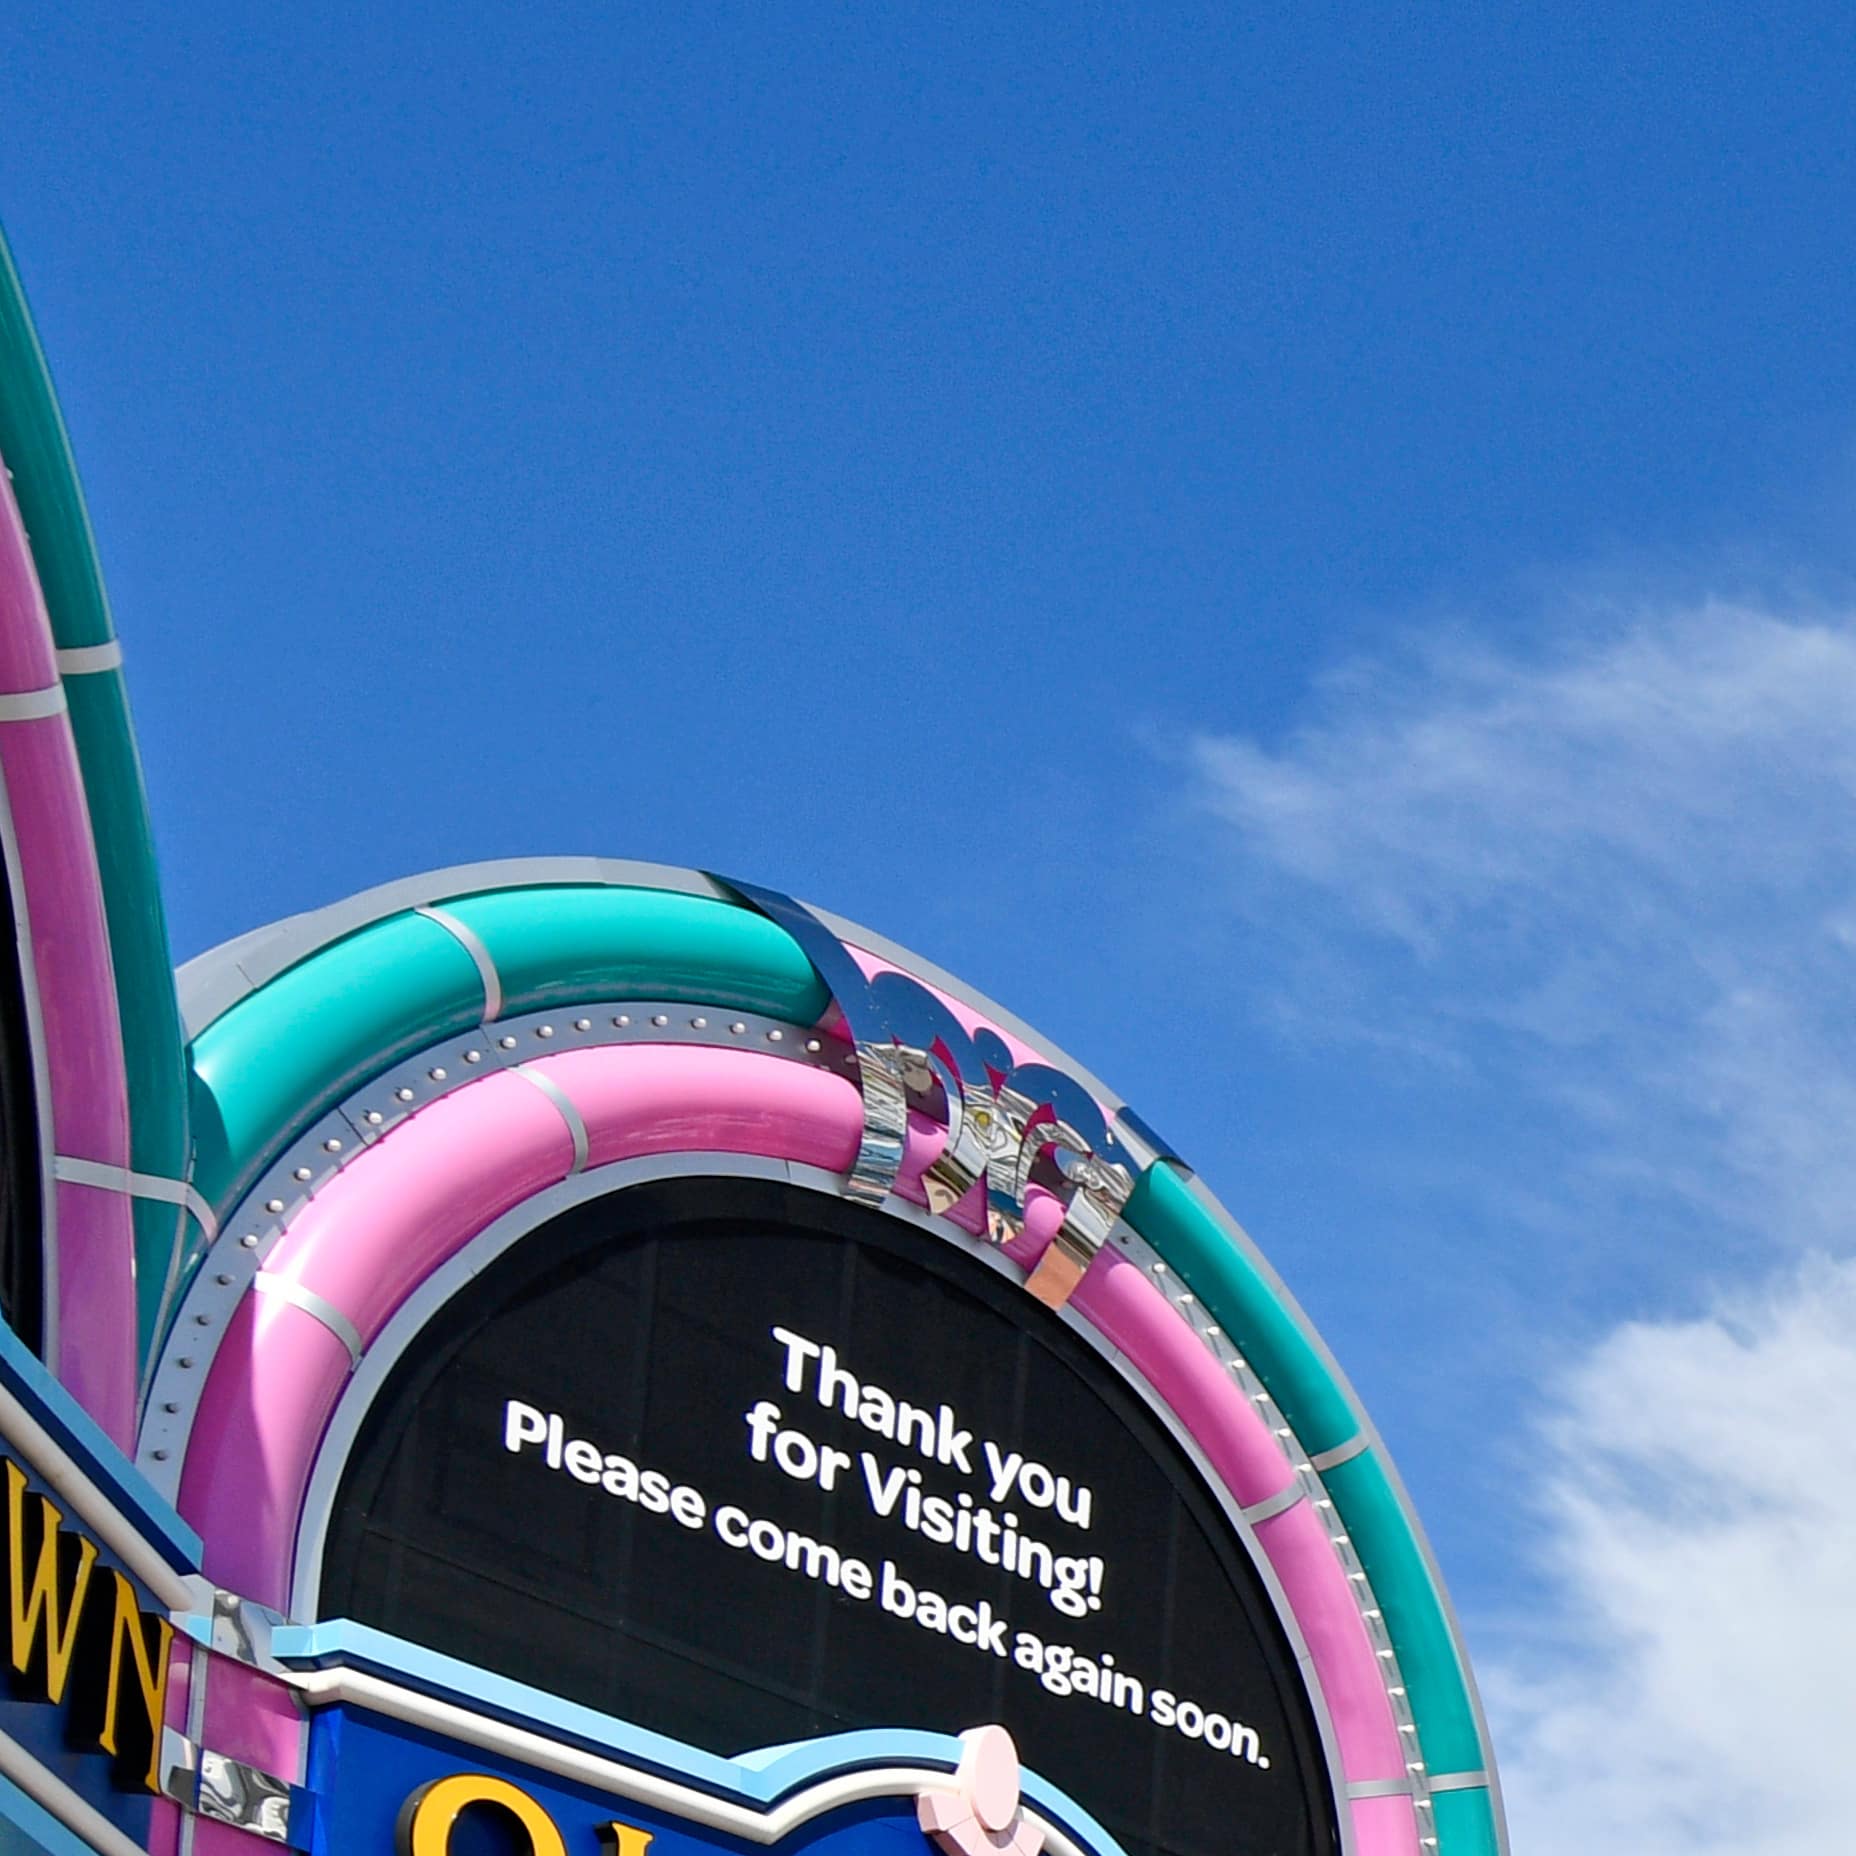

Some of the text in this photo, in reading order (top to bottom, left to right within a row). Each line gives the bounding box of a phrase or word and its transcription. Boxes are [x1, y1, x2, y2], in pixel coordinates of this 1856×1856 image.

[745, 1401, 1104, 1618] for Visiting!
[772, 1326, 1092, 1529] Thank you
[504, 1400, 1272, 1769] Please come back again soon.
